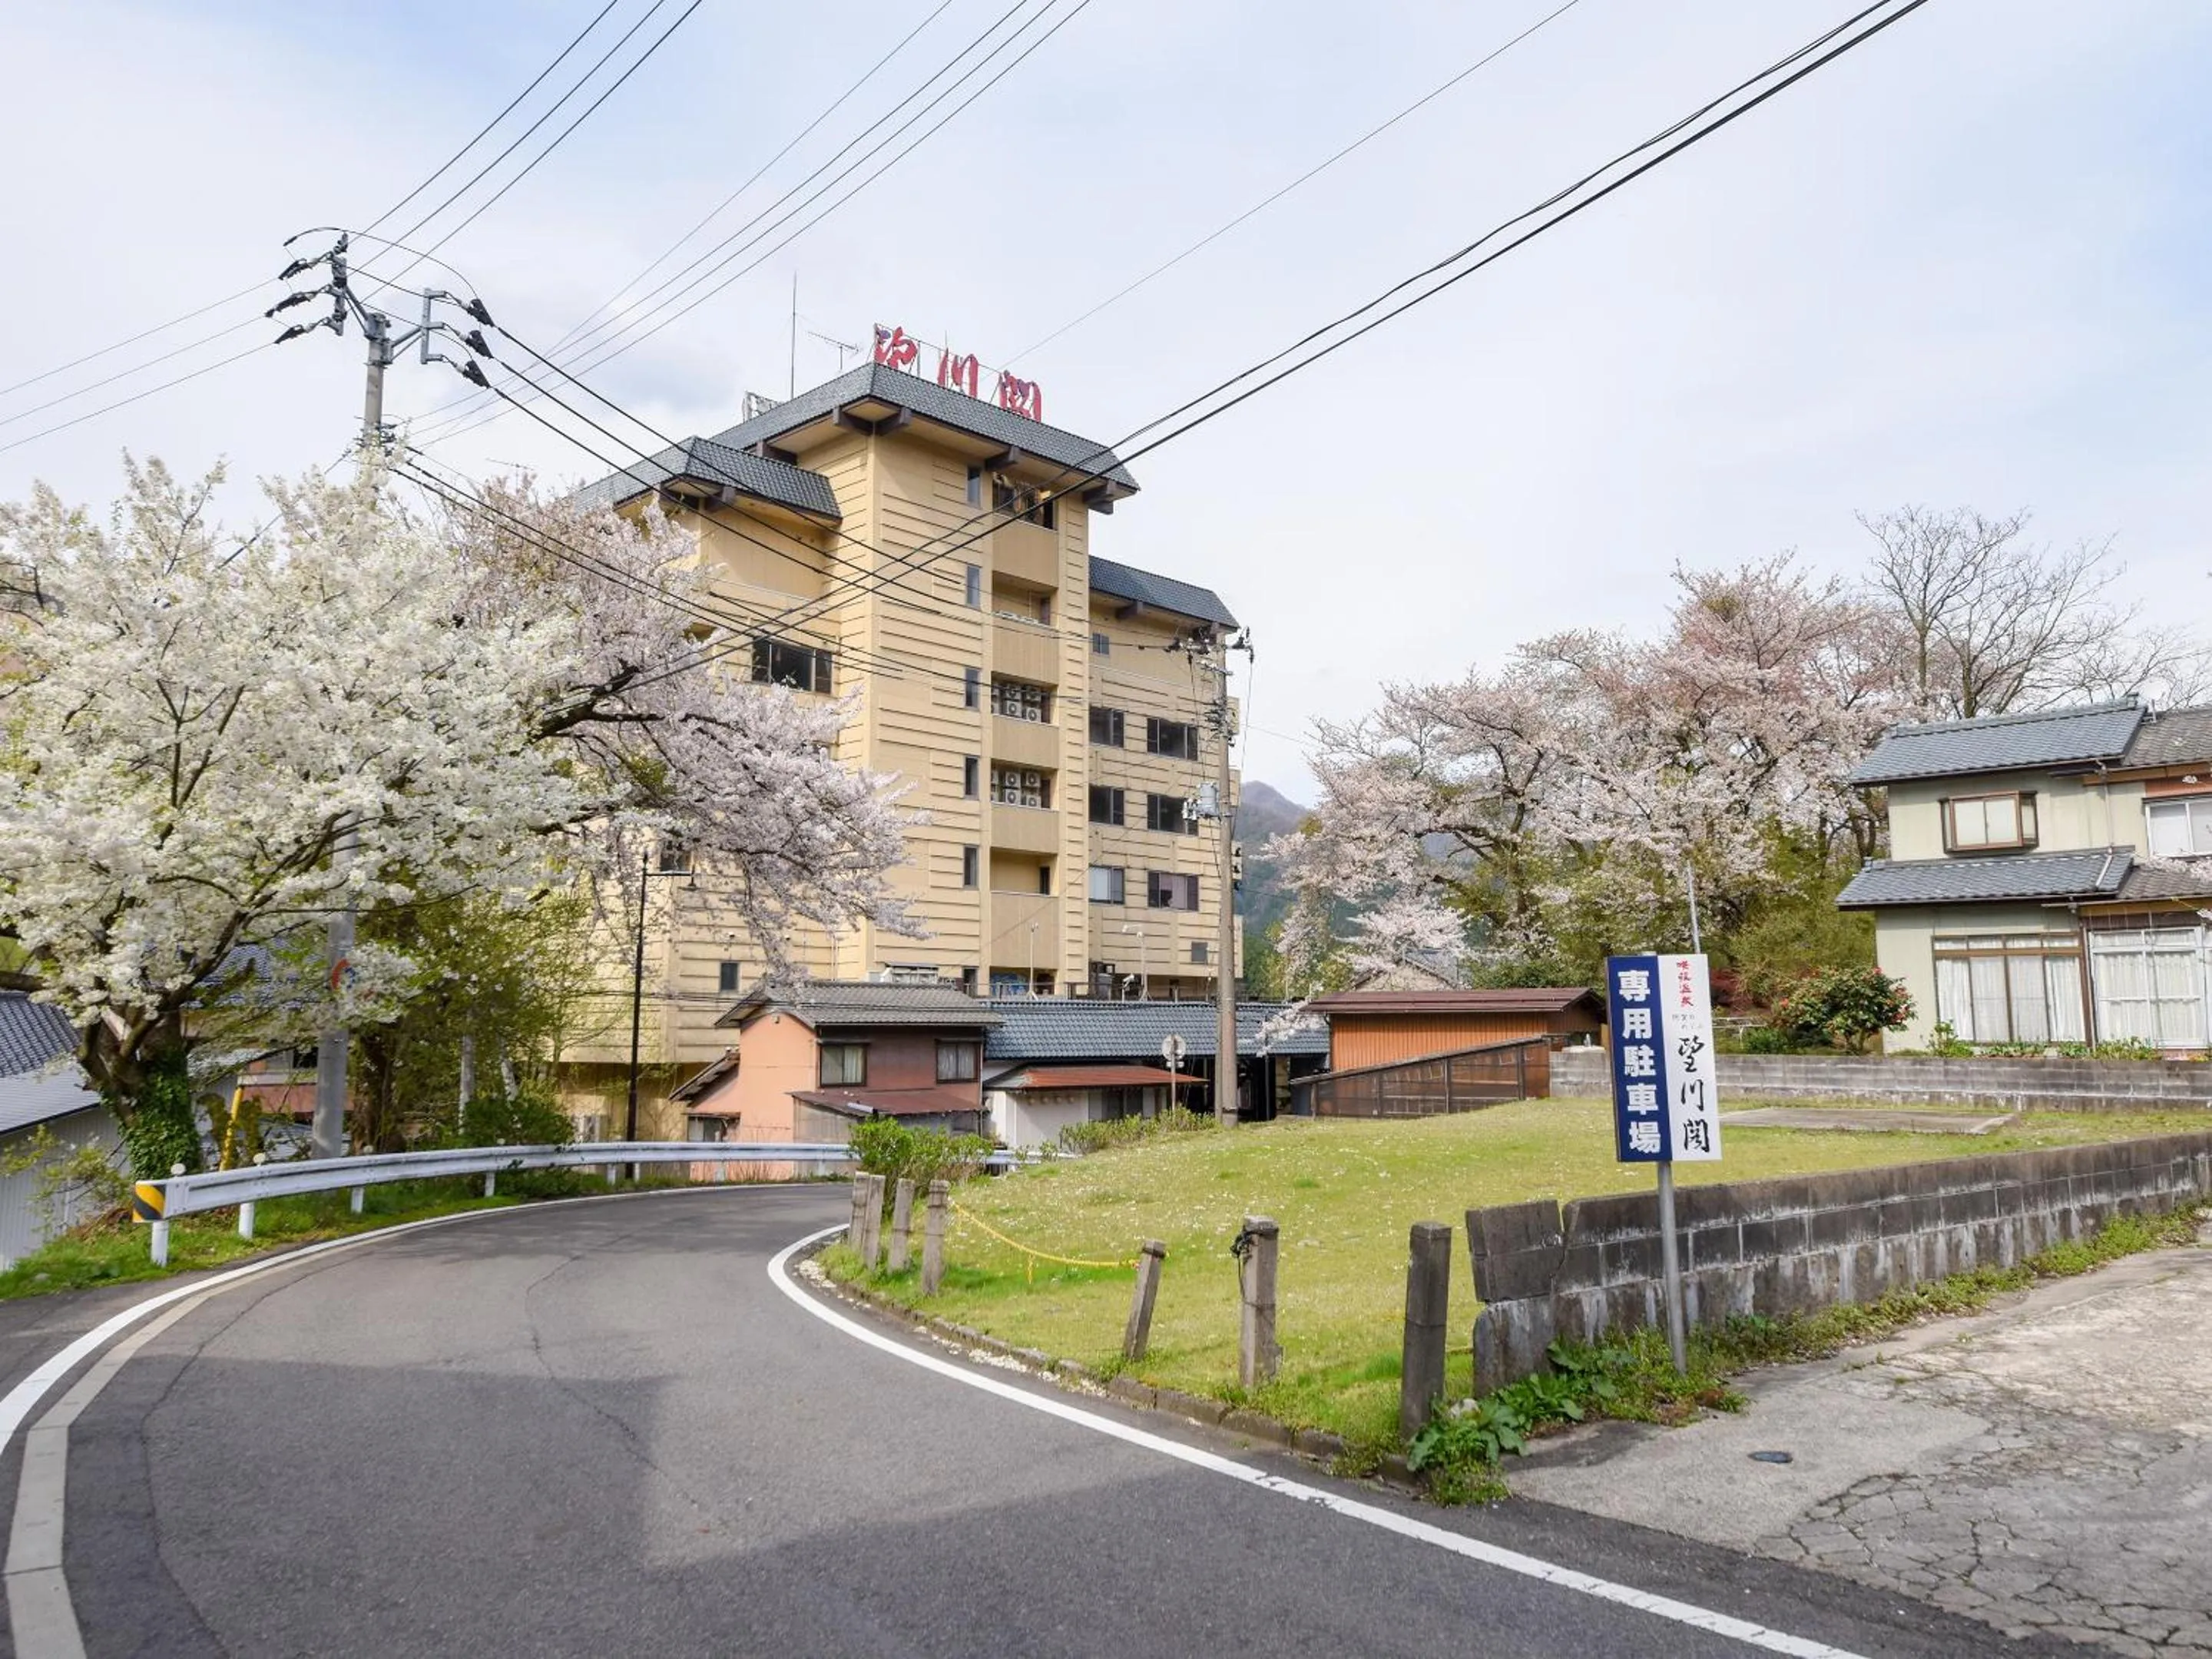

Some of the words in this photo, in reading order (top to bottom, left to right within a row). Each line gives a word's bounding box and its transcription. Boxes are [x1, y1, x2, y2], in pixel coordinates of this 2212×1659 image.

[1618, 969, 1661, 1154] 専用駐車場
